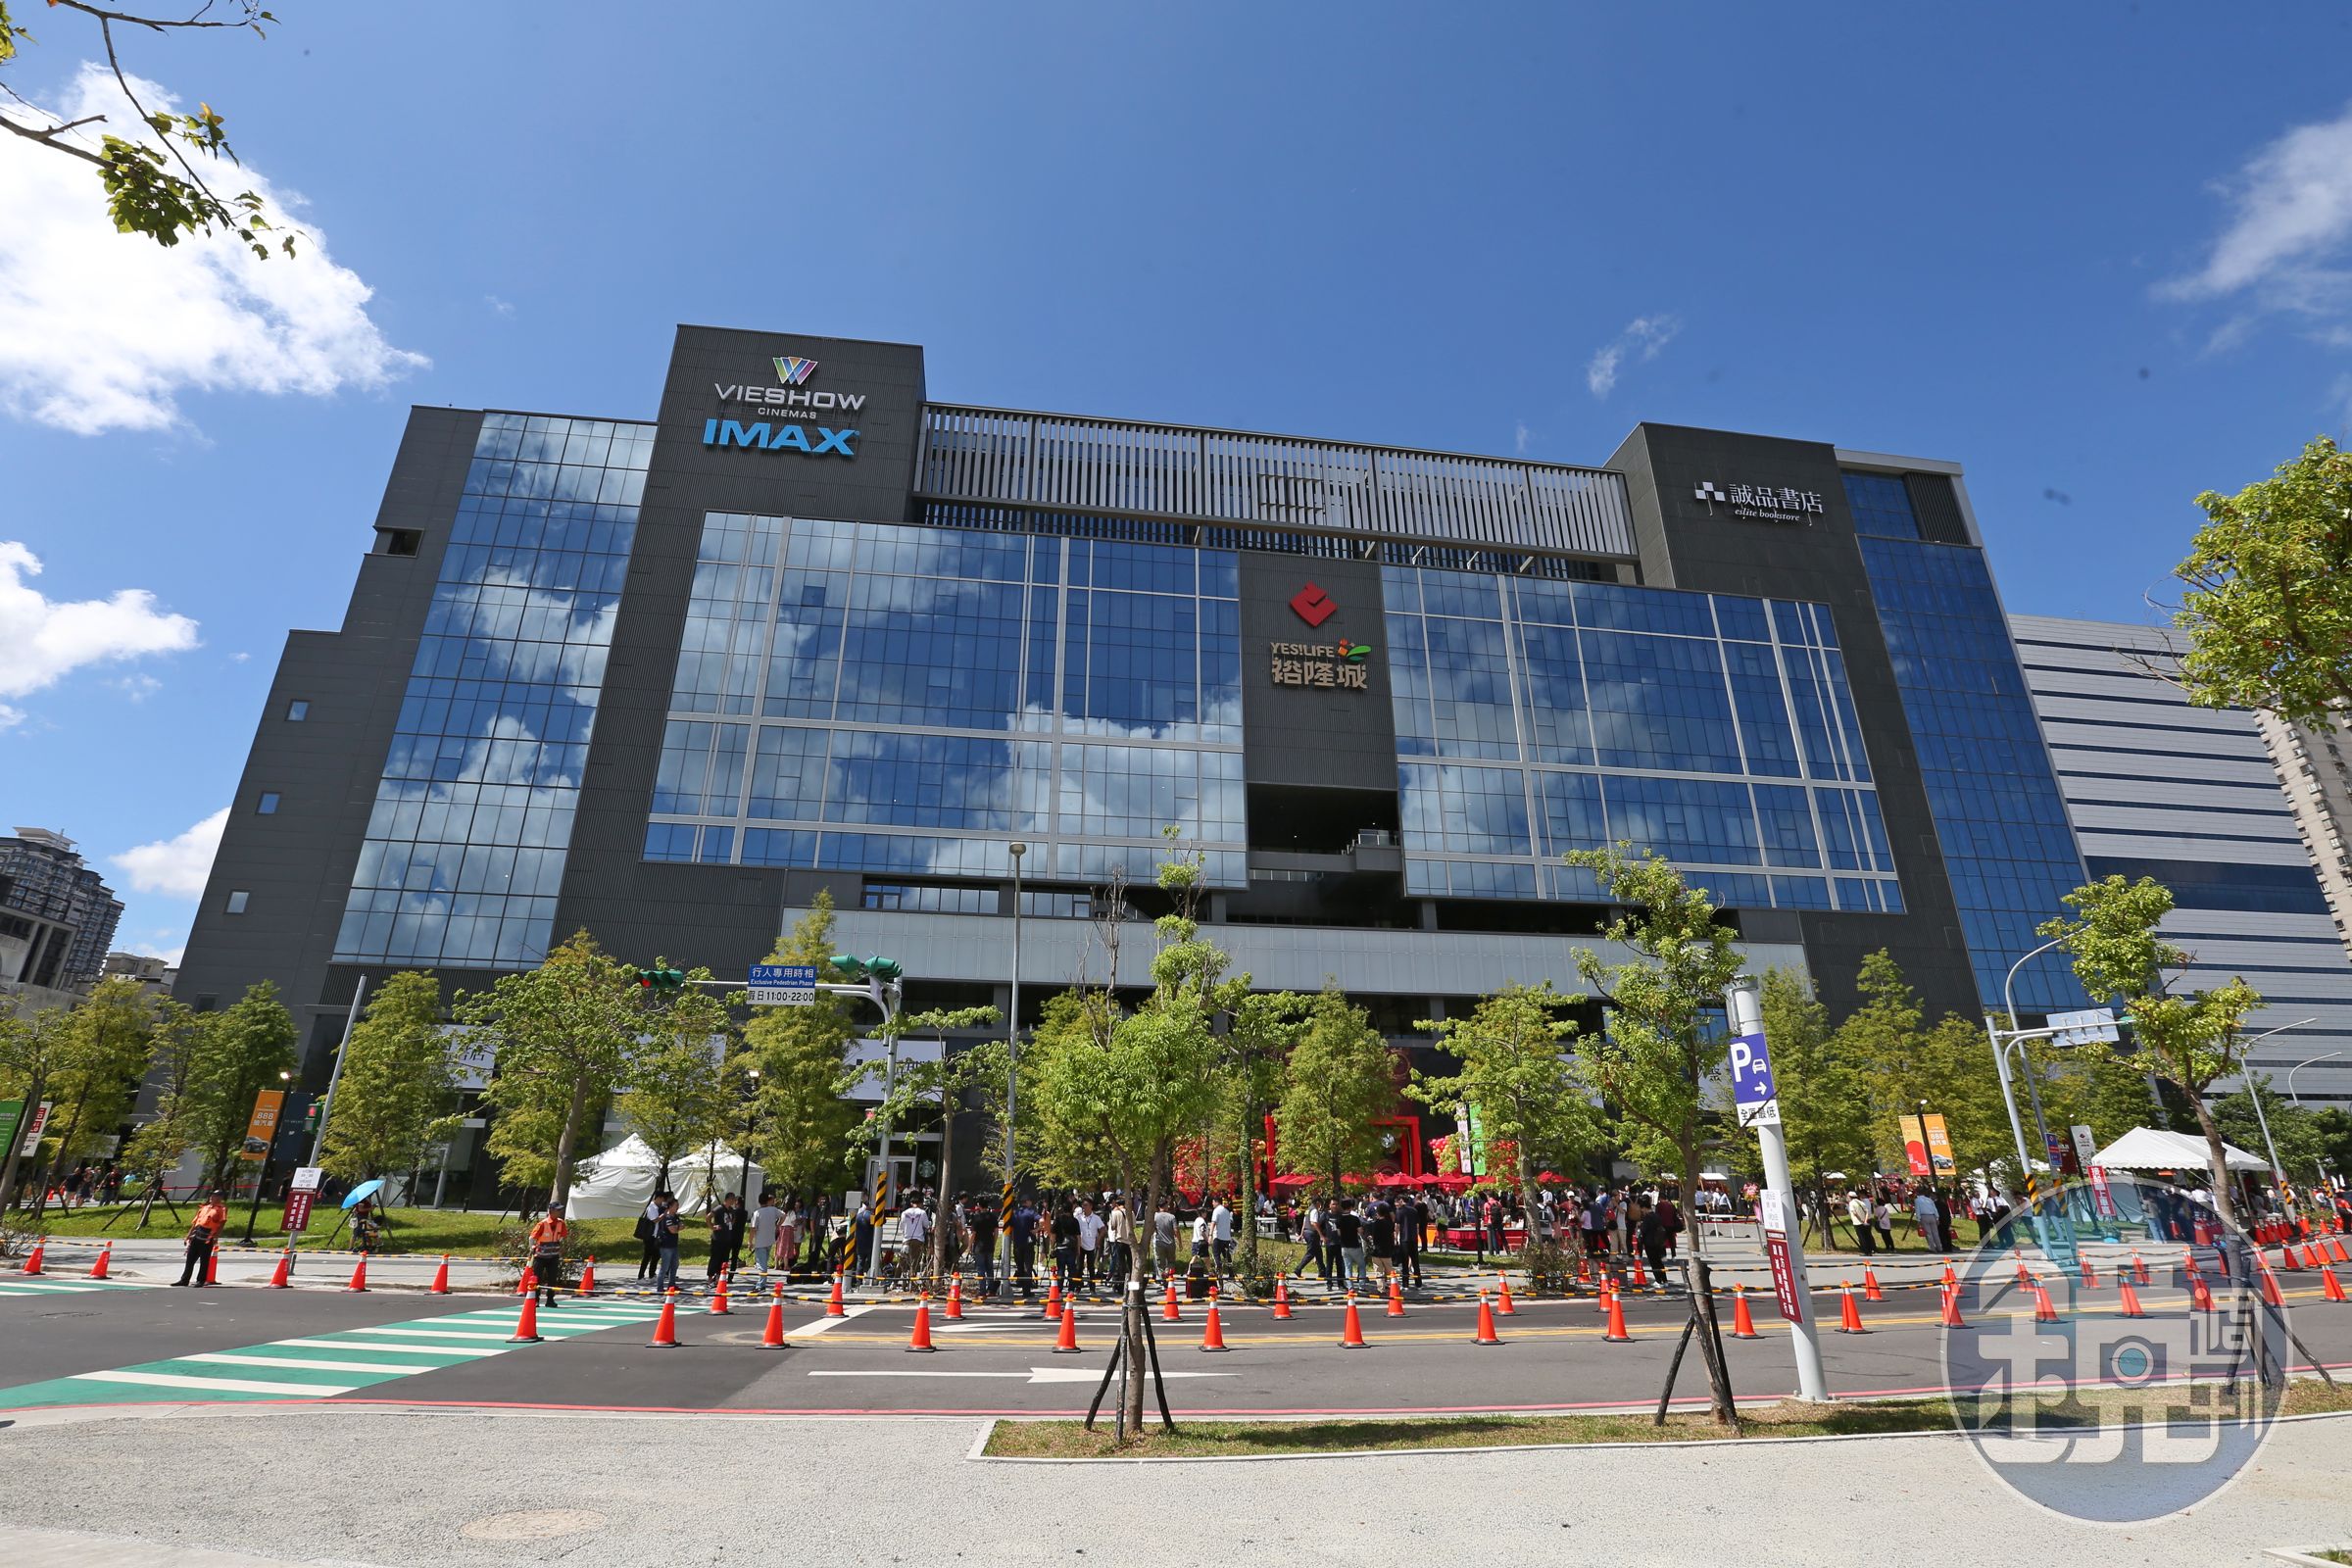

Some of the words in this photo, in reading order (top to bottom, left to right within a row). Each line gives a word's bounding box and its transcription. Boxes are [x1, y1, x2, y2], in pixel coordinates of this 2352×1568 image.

[714, 383, 866, 411] VIESHOW
[758, 407, 817, 419] CINEMAS
[703, 418, 856, 456] IMAX
[1729, 483, 1824, 514] 誠品書店
[1735, 508, 1757, 517] eslite
[1759, 510, 1800, 521] bookstore
[1270, 642, 1335, 658] YES!LIFE
[1271, 657, 1368, 689] 裕隆城
[752, 966, 813, 978] 行人專用時相
[1730, 1042, 1751, 1082] P
